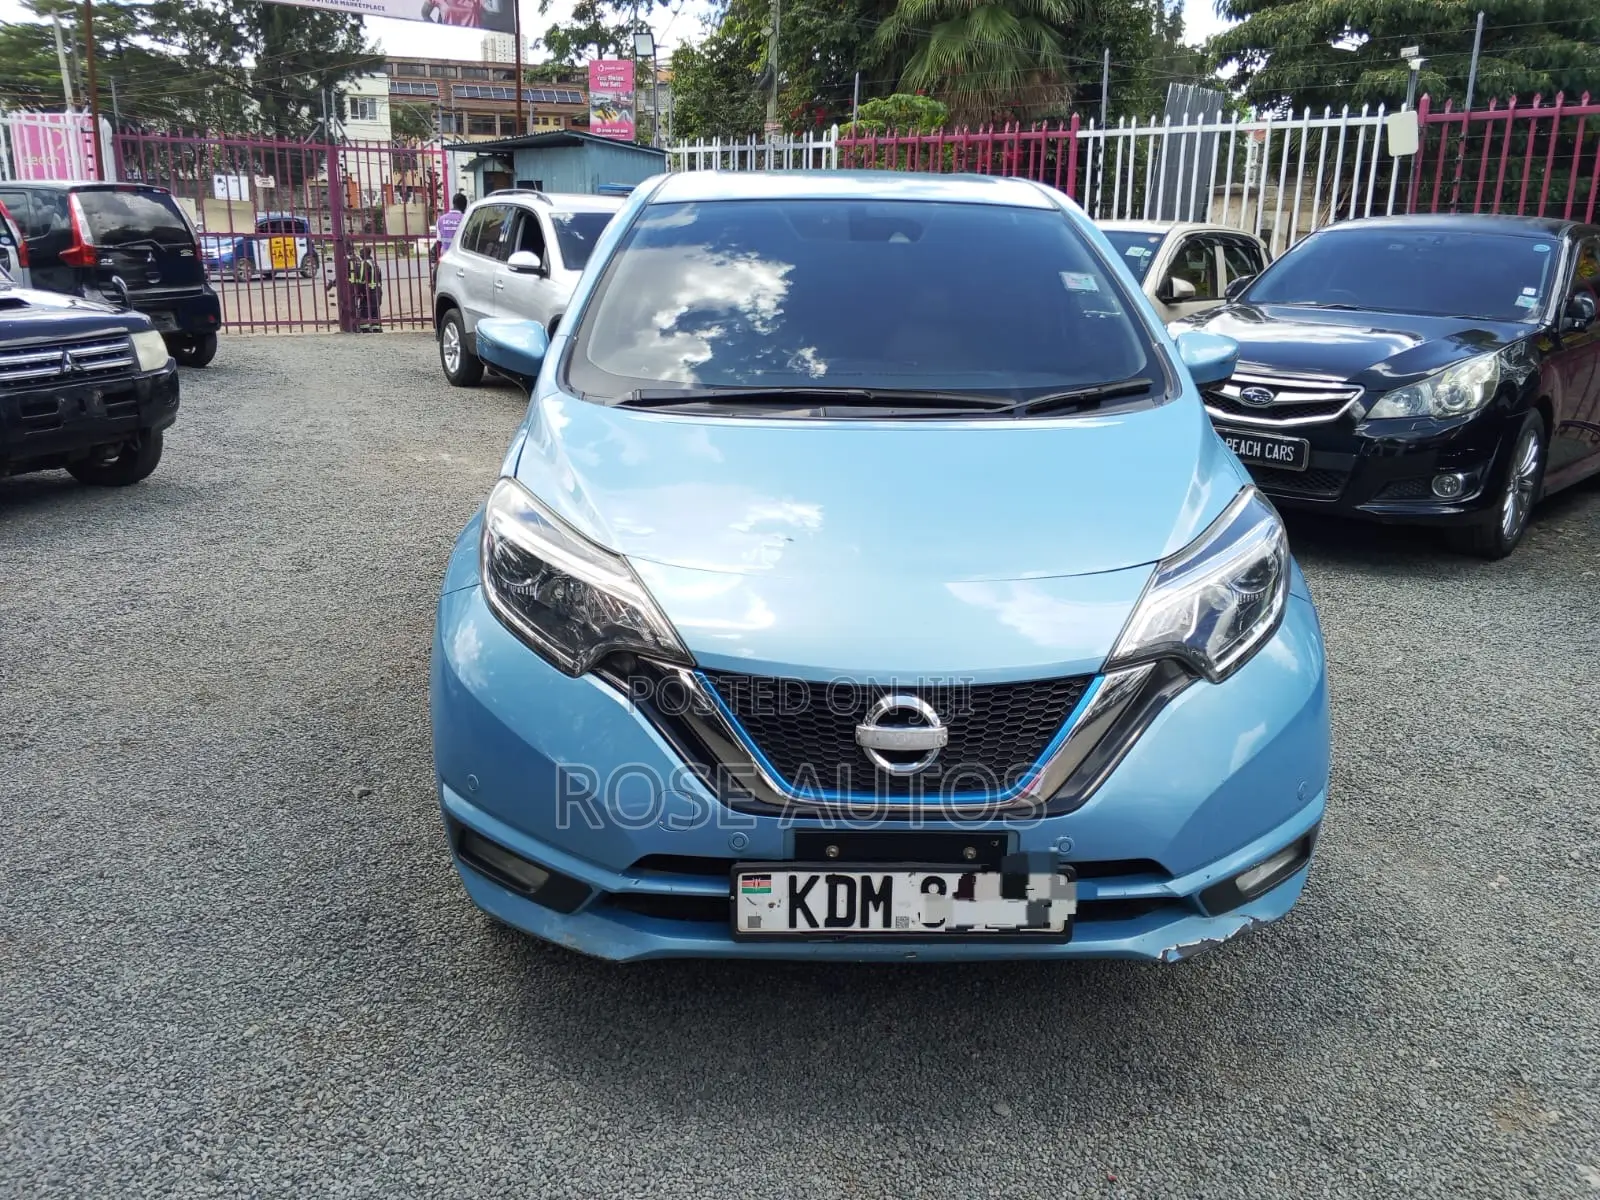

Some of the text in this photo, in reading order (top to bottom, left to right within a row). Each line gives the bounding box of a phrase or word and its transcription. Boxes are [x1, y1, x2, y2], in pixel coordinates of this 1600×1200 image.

[340, 0, 386, 12] MARKETPLACE
[1225, 438, 1295, 462] PEACH CARS
[788, 874, 893, 929] KDM
